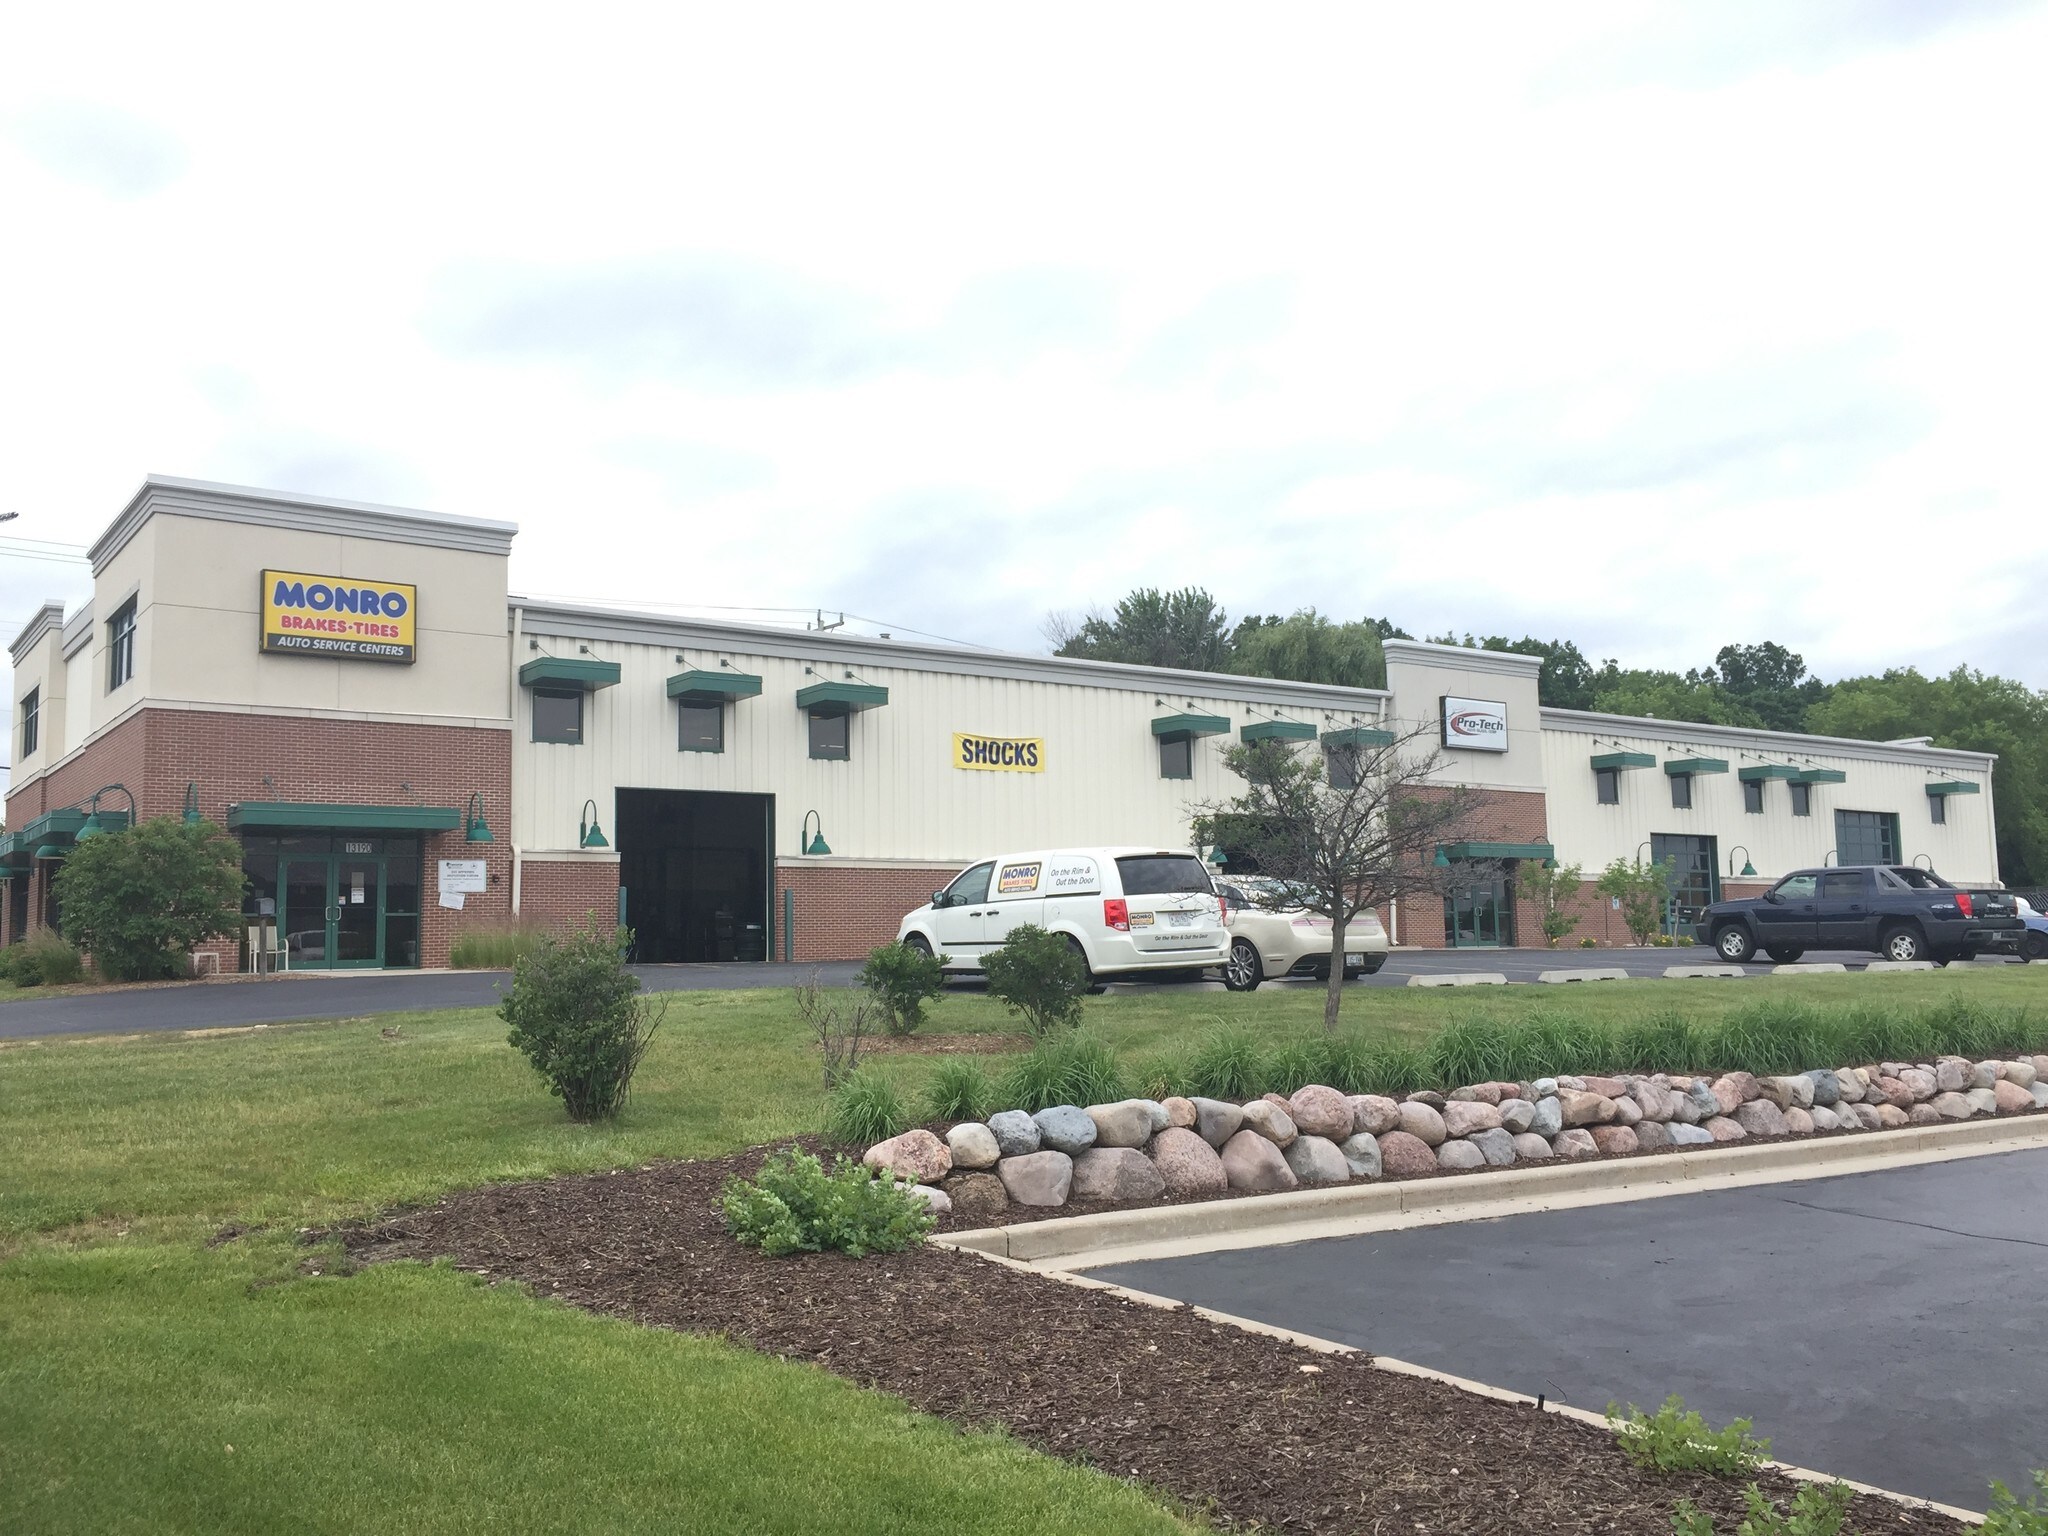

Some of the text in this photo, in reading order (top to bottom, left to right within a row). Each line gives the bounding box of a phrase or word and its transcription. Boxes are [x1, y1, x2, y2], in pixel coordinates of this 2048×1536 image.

[273, 580, 408, 618] MONRO
[281, 615, 399, 638] BRAKES TIRES
[277, 636, 404, 656] AUTO SERVICE CENTERS
[1457, 717, 1503, 731] Pro-Tech
[962, 738, 1038, 767] SHOCKS
[347, 842, 372, 853] 13190
[1003, 867, 1037, 879] MONRO
[1051, 866, 1091, 877] On the Rim &
[1055, 876, 1095, 886] Out the Door
